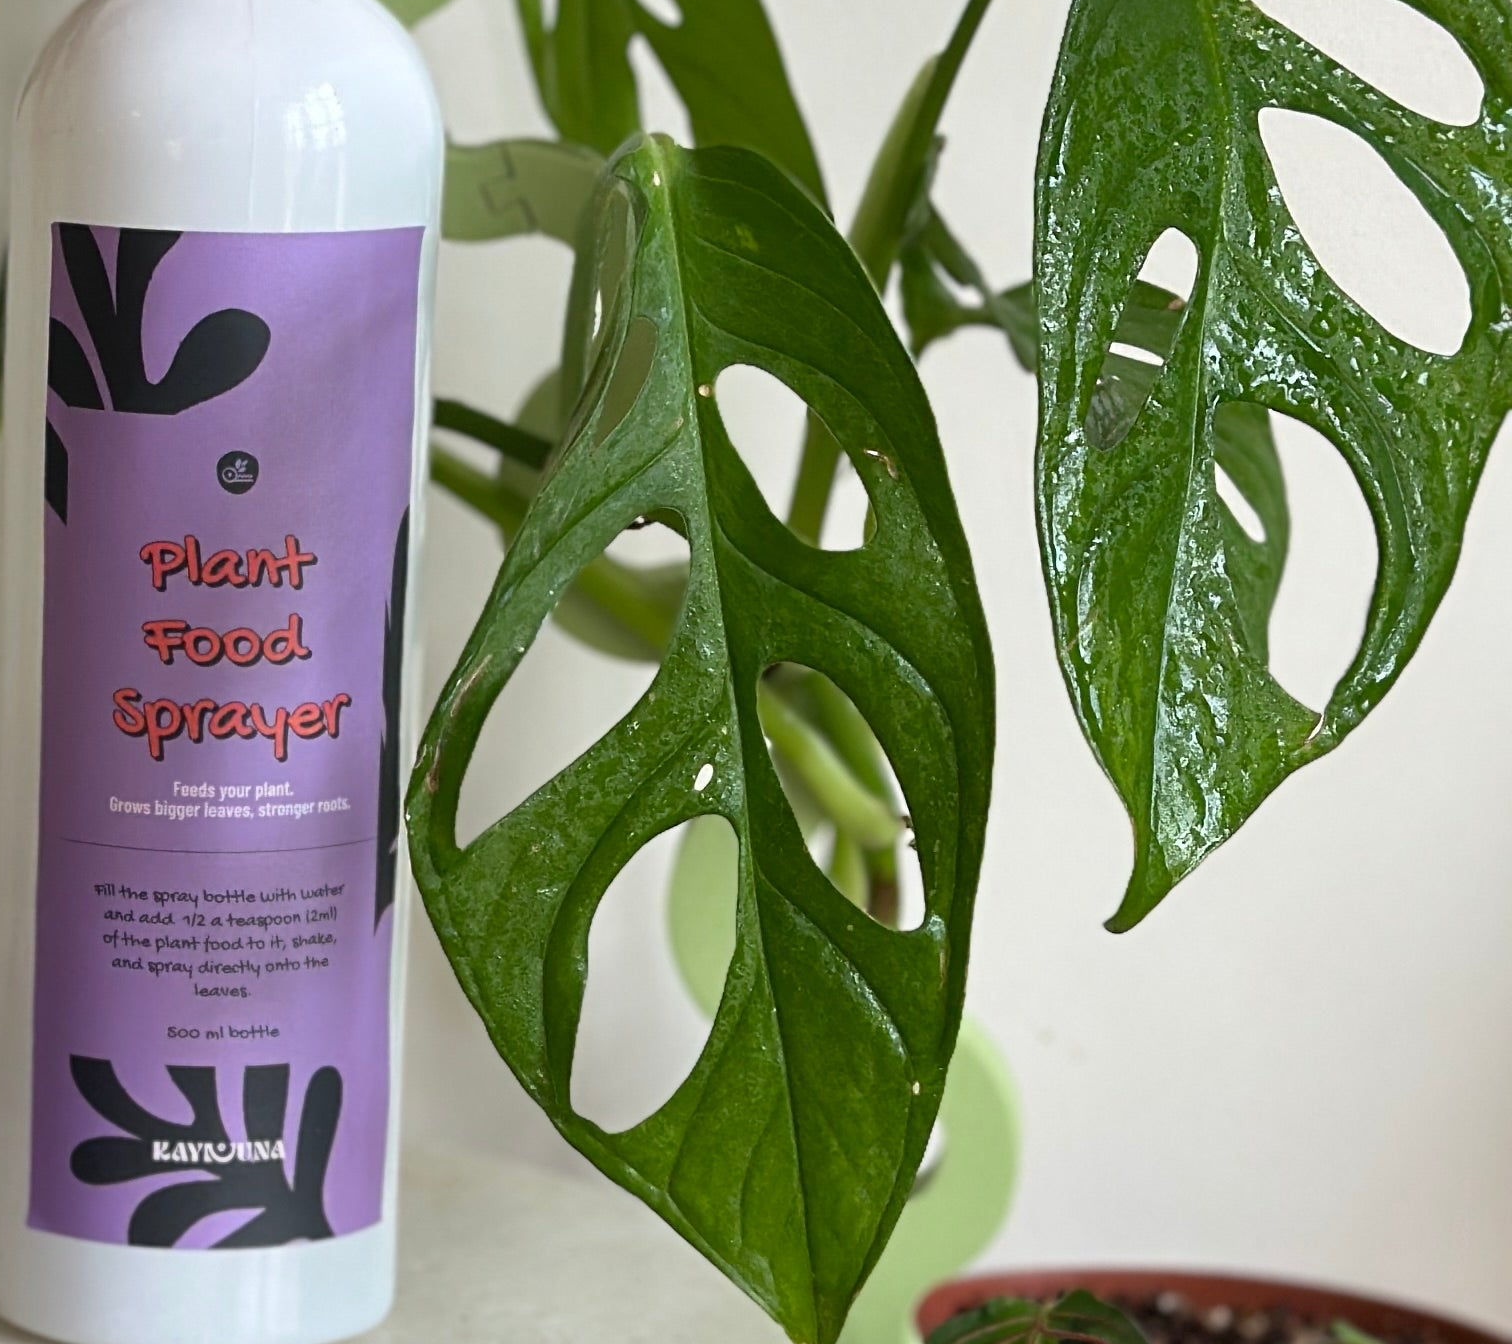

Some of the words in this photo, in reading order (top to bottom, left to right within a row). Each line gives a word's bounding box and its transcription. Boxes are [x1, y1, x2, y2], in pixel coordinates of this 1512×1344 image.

[140, 534, 318, 592] Plant
[141, 612, 313, 666] Food
[112, 687, 352, 761] Sprayer
[173, 781, 216, 798] Feeds
[219, 783, 252, 801] your
[255, 781, 294, 799] plant.
[109, 796, 151, 816] Grows
[154, 800, 201, 820] bigger
[204, 803, 255, 819] leaves,
[258, 800, 314, 819] stronger
[317, 797, 351, 812] roots.
[94, 883, 115, 897] Fill
[118, 885, 149, 900] the
[152, 891, 198, 909] spray
[203, 889, 256, 904] bottle
[259, 887, 297, 903] with
[300, 883, 345, 900] water
[104, 910, 135, 922] and
[139, 912, 175, 925] add
[182, 913, 206, 927] 1/2
[210, 916, 223, 927] a
[226, 913, 301, 931] teaspoon
[305, 903, 337, 924] (2ml)
[102, 929, 118, 948] of
[120, 931, 151, 947] the
[155, 935, 201, 953] plant
[202, 936, 244, 953] food
[246, 936, 265, 950] to
[269, 935, 286, 950] it,
[291, 932, 337, 948] shake,
[111, 957, 144, 970] and
[148, 960, 193, 979] spray
[198, 960, 261, 978] directly
[264, 958, 301, 972] onto
[303, 955, 329, 968] the
[193, 983, 252, 997] leaves.
[167, 1026, 200, 1039] 500
[205, 1026, 223, 1040] ml
[228, 1025, 280, 1039] bottle
